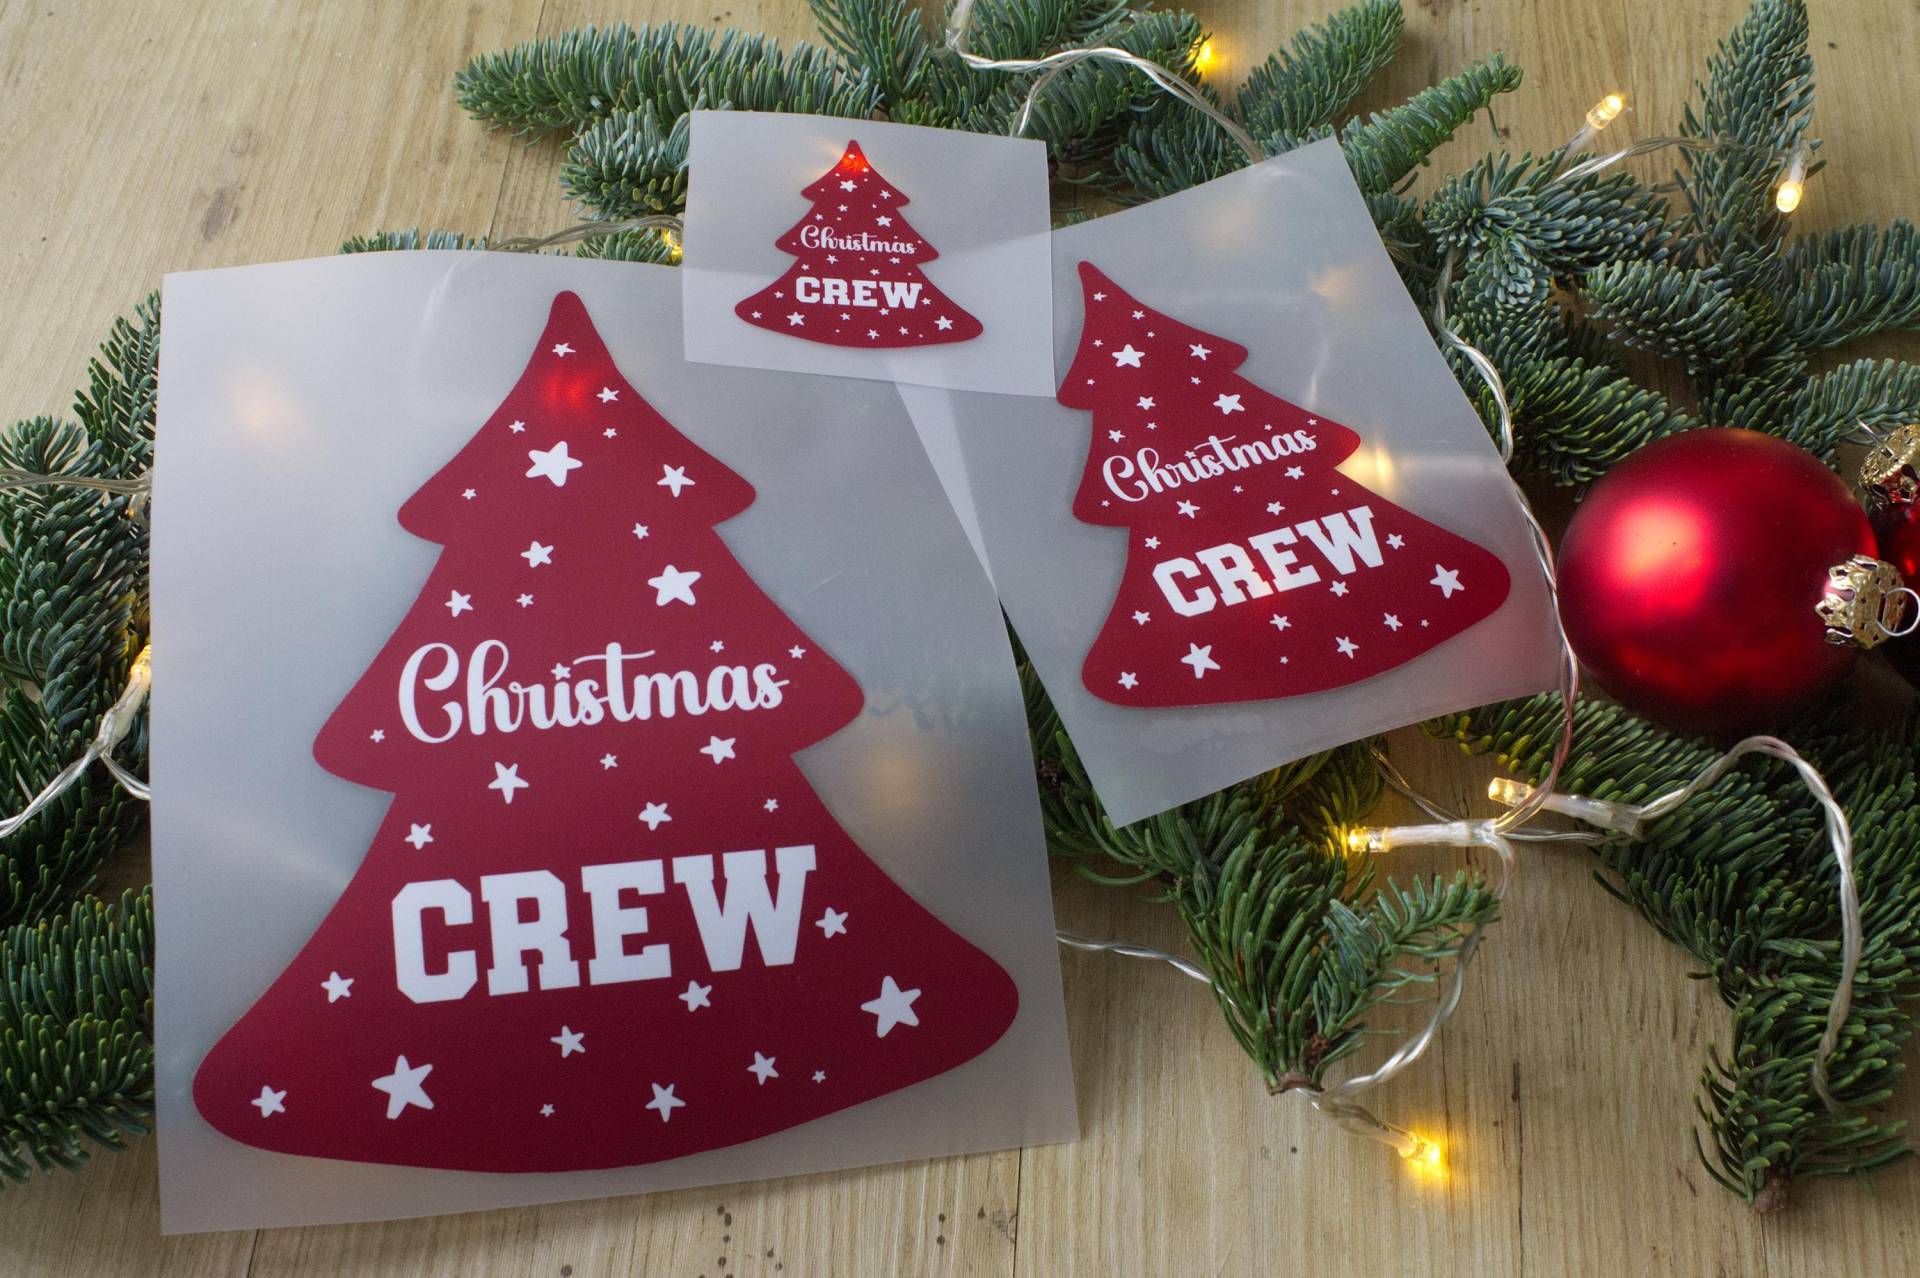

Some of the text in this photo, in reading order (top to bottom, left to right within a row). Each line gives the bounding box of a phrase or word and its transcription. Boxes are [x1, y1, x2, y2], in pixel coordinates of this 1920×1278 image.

[800, 225, 917, 255] Christmas
[795, 276, 923, 309] CREW
[1102, 429, 1317, 502] Christmas
[1152, 505, 1385, 618] CREW
[398, 639, 790, 744] Christmas
[391, 844, 817, 1004] CREW
